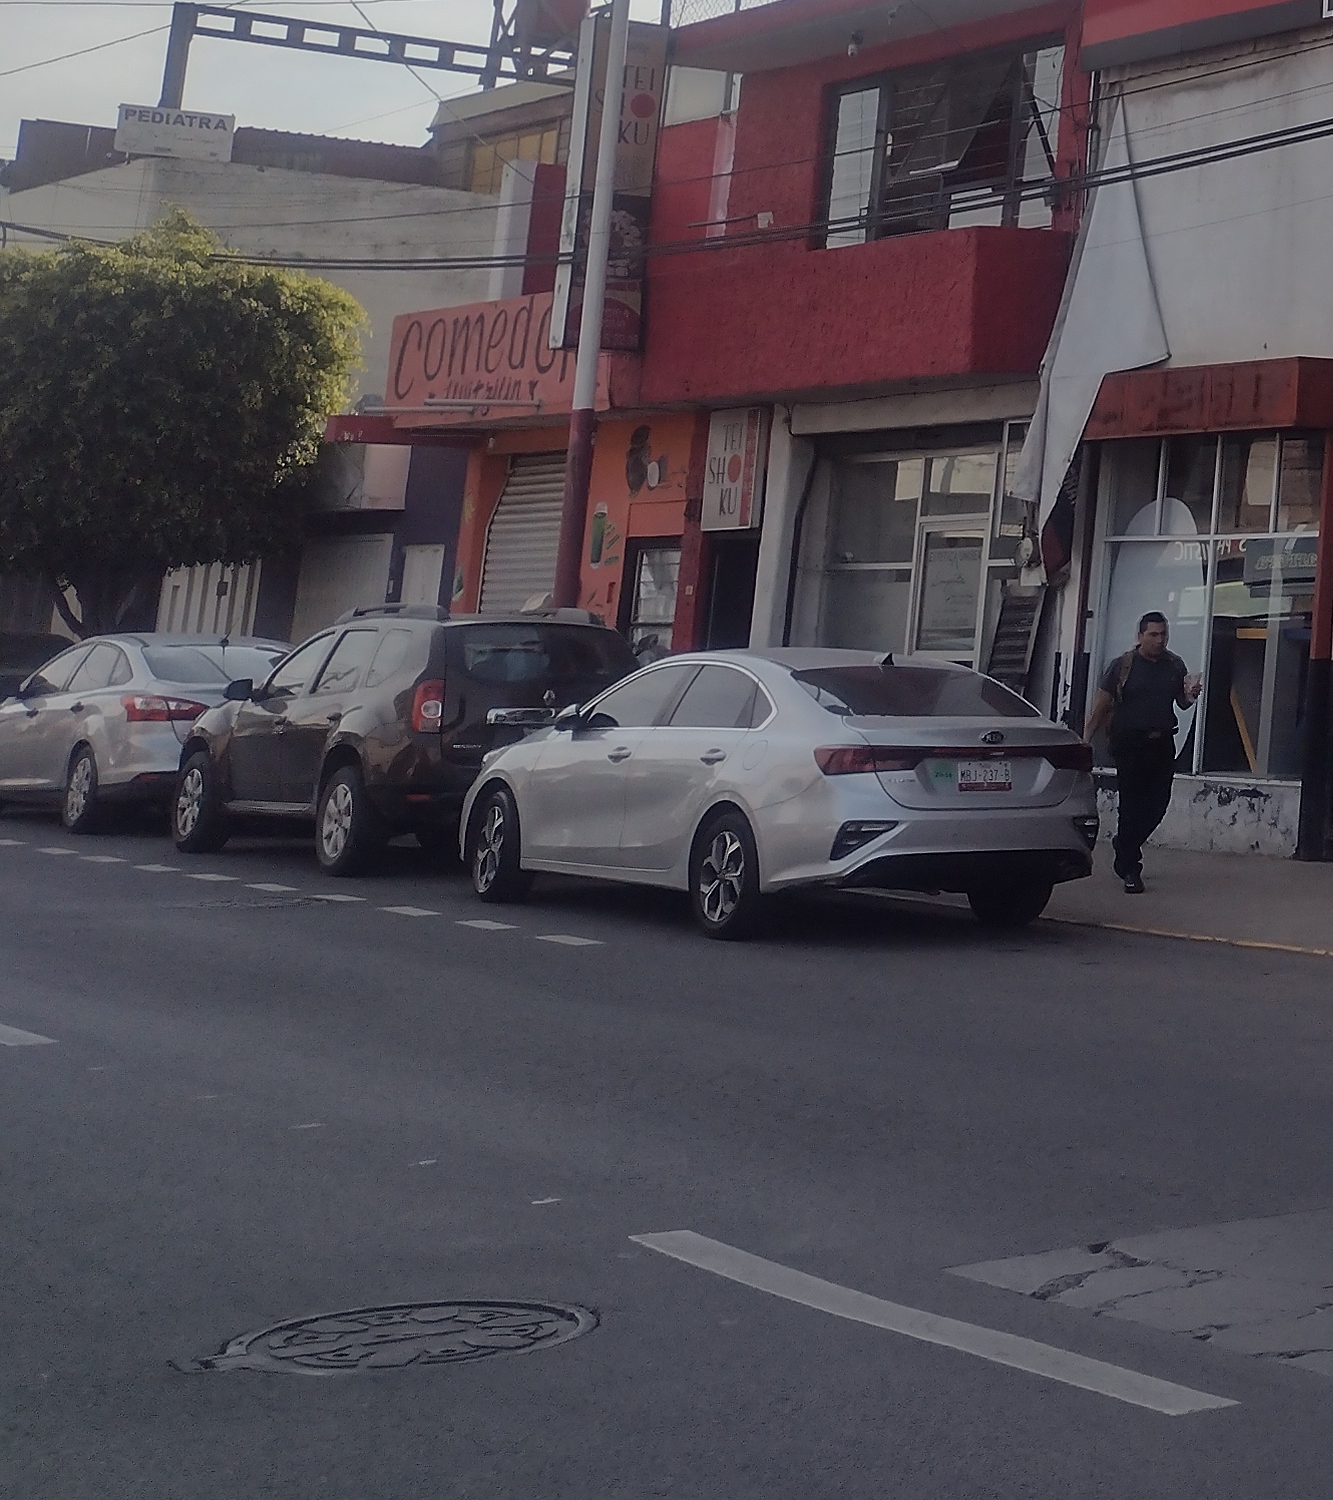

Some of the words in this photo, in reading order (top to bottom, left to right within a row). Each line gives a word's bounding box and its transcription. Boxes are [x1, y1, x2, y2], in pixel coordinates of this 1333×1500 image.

[124, 108, 227, 131] PEDIATRA
[723, 422, 743, 451] TEI
[719, 487, 738, 515] KU
